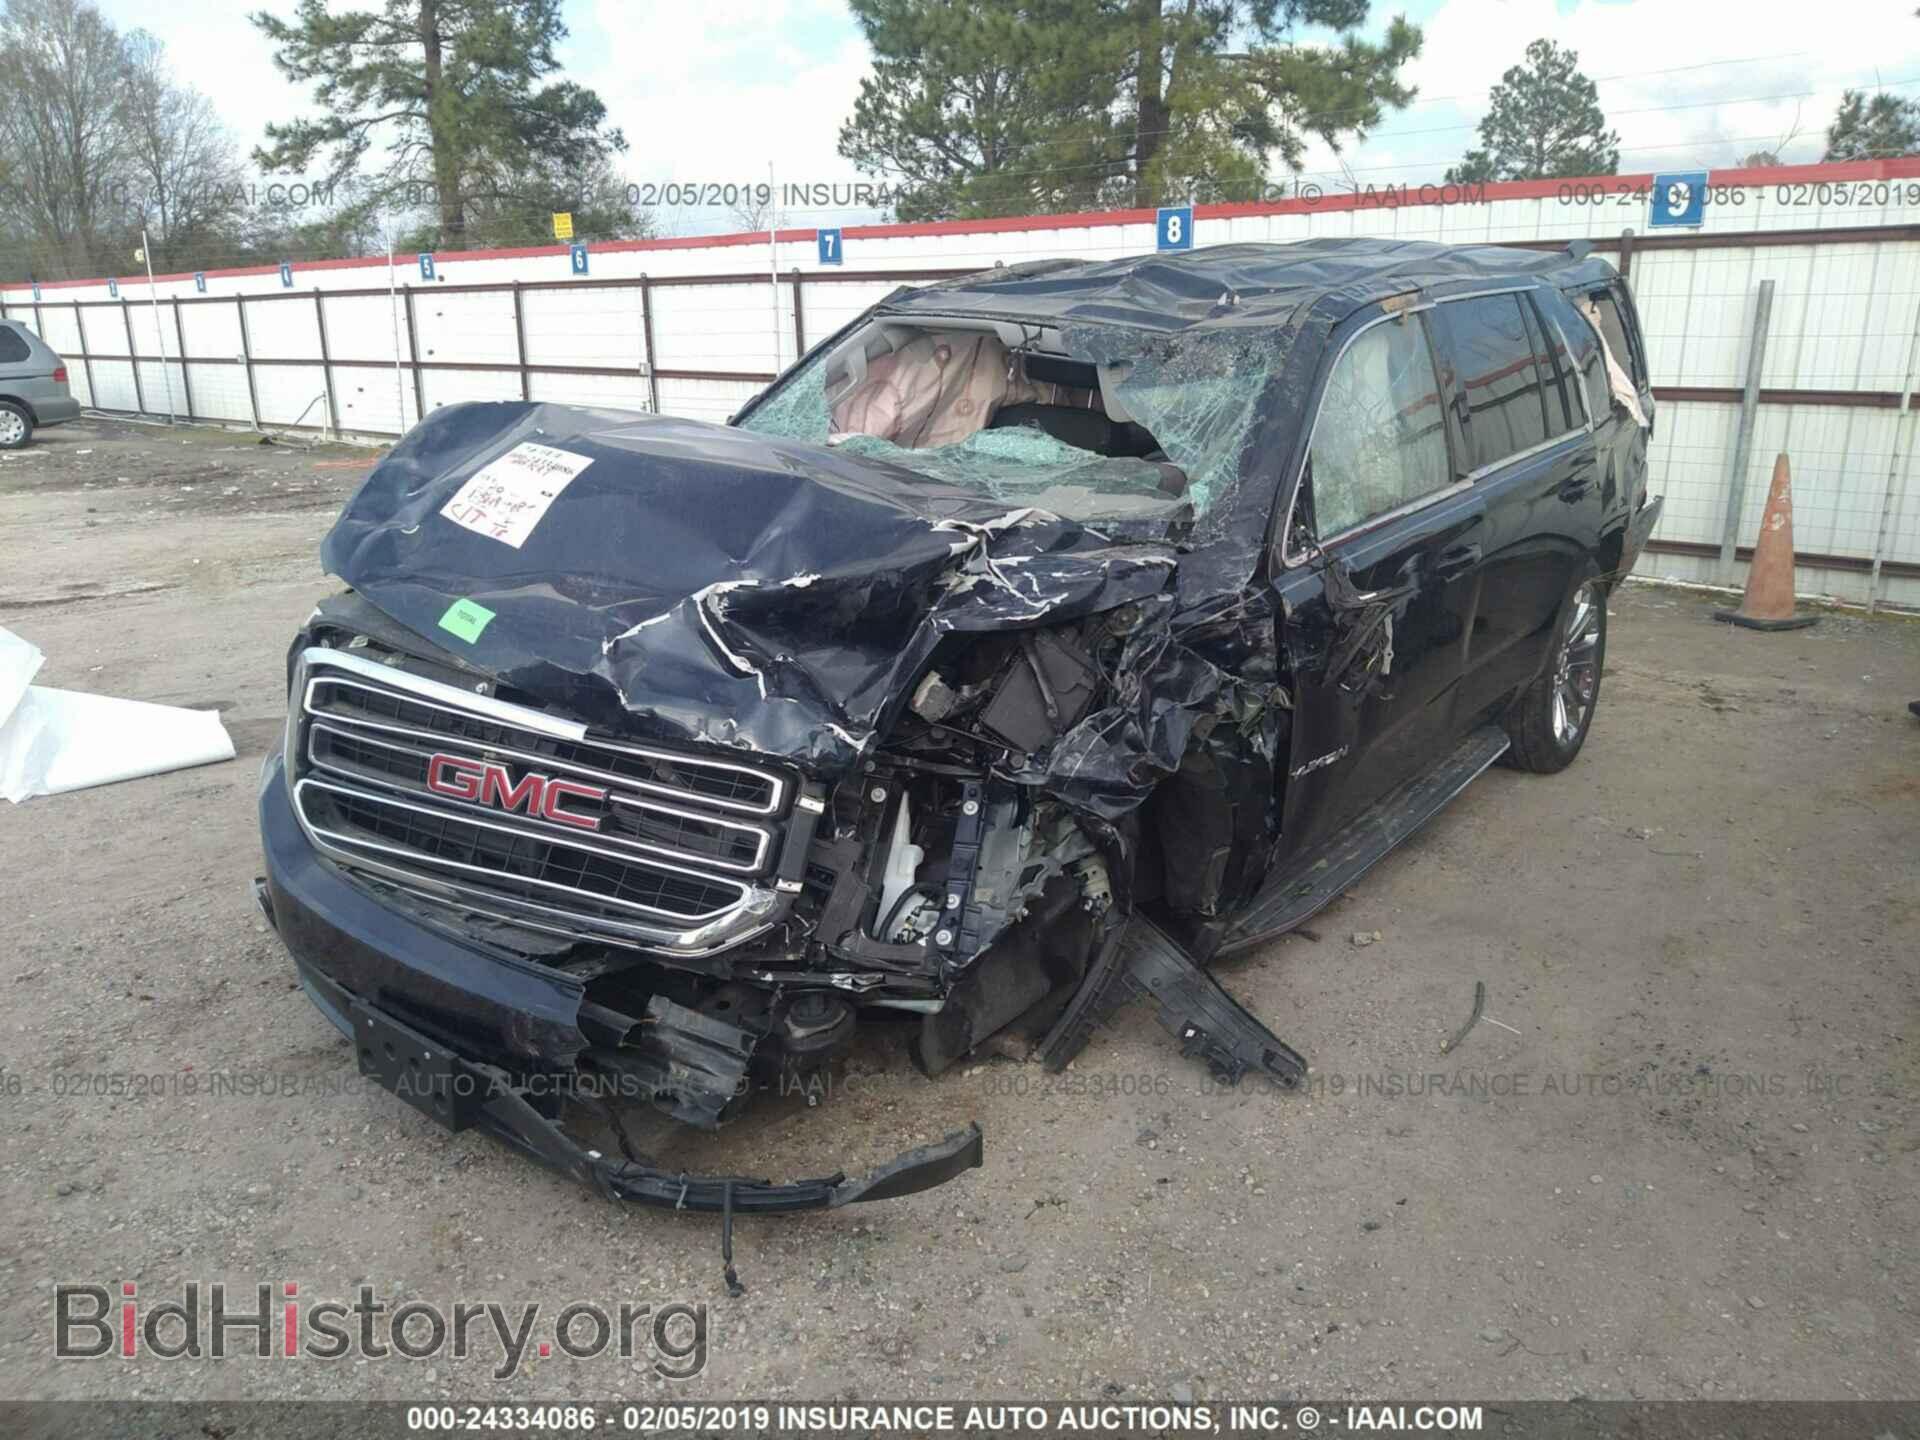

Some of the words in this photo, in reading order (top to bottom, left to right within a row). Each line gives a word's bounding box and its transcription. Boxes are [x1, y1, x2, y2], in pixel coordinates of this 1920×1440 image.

[1667, 181, 1690, 217] 9
[1167, 215, 1182, 243] 8
[824, 235, 835, 257] 7
[423, 258, 432, 275] 5
[575, 250, 584, 269] 6
[427, 752, 609, 831] GMC
